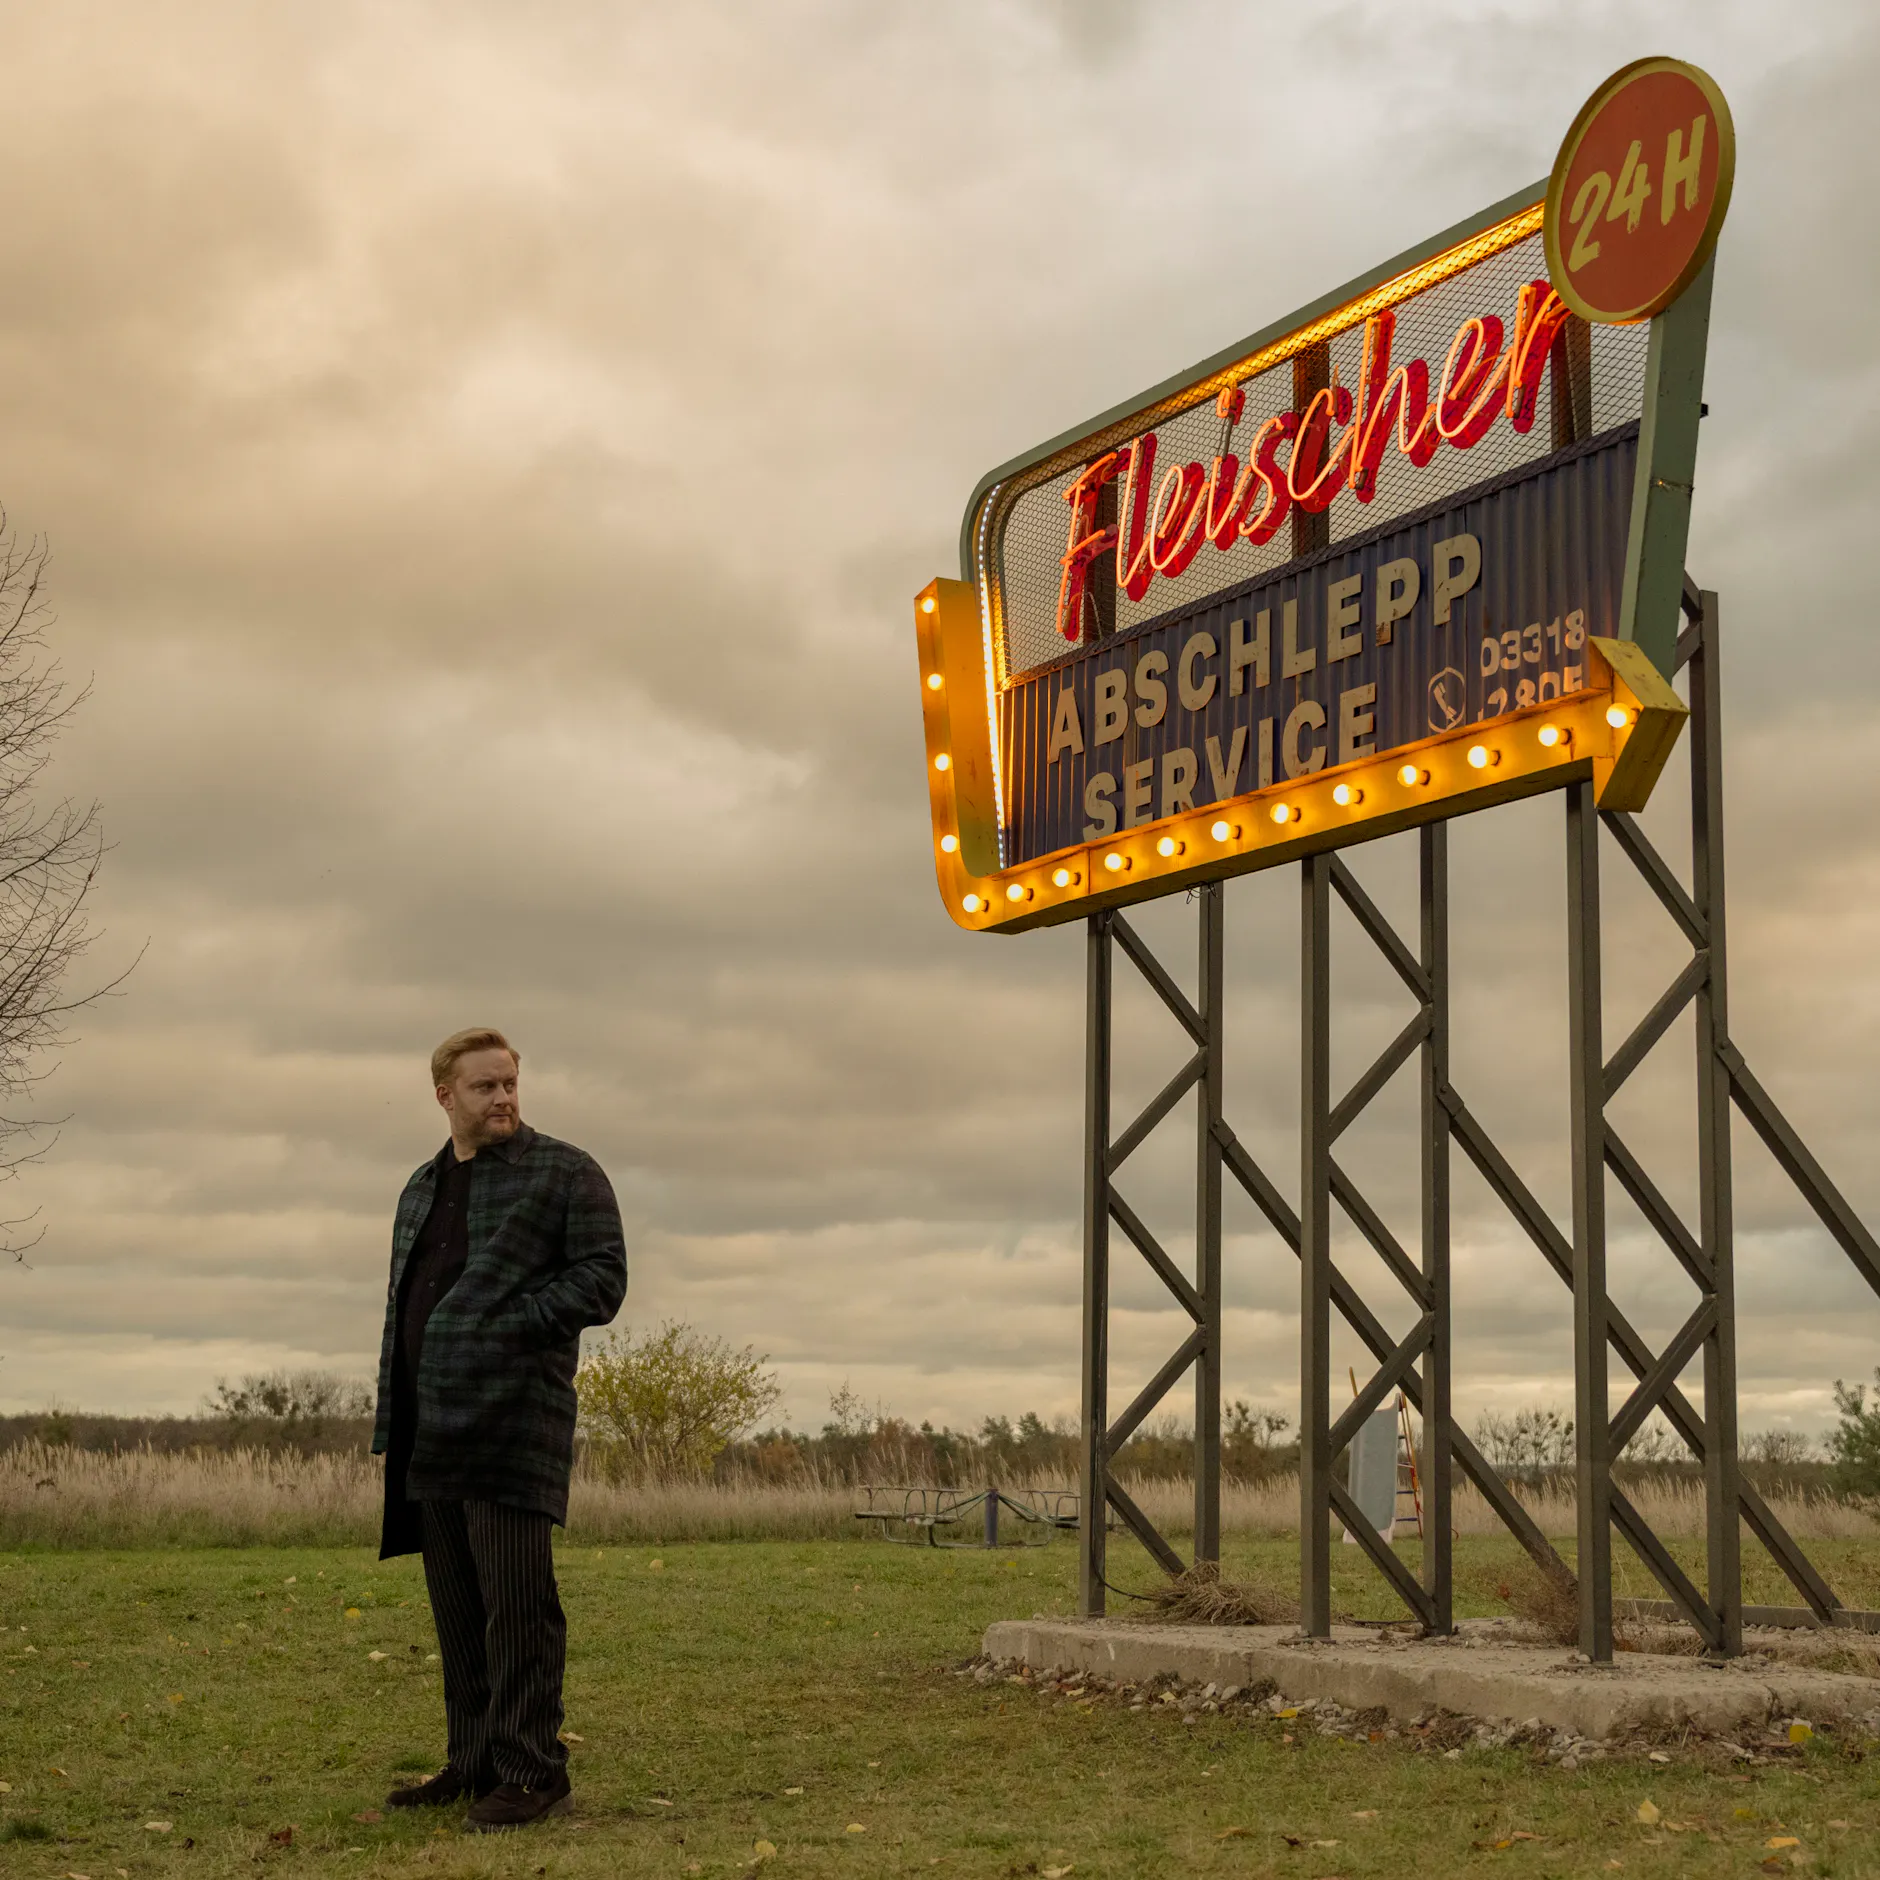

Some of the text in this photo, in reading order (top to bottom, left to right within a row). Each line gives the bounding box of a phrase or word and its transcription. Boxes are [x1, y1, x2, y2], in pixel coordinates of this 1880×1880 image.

[1568, 114, 1707, 272] 24H
[1056, 279, 1572, 642] Fleischer
[1047, 533, 1482, 764] ABSCHLEPP
[1477, 663, 1583, 722] 2805
[1480, 608, 1586, 677] 03318
[1082, 682, 1377, 842] SERVICE
